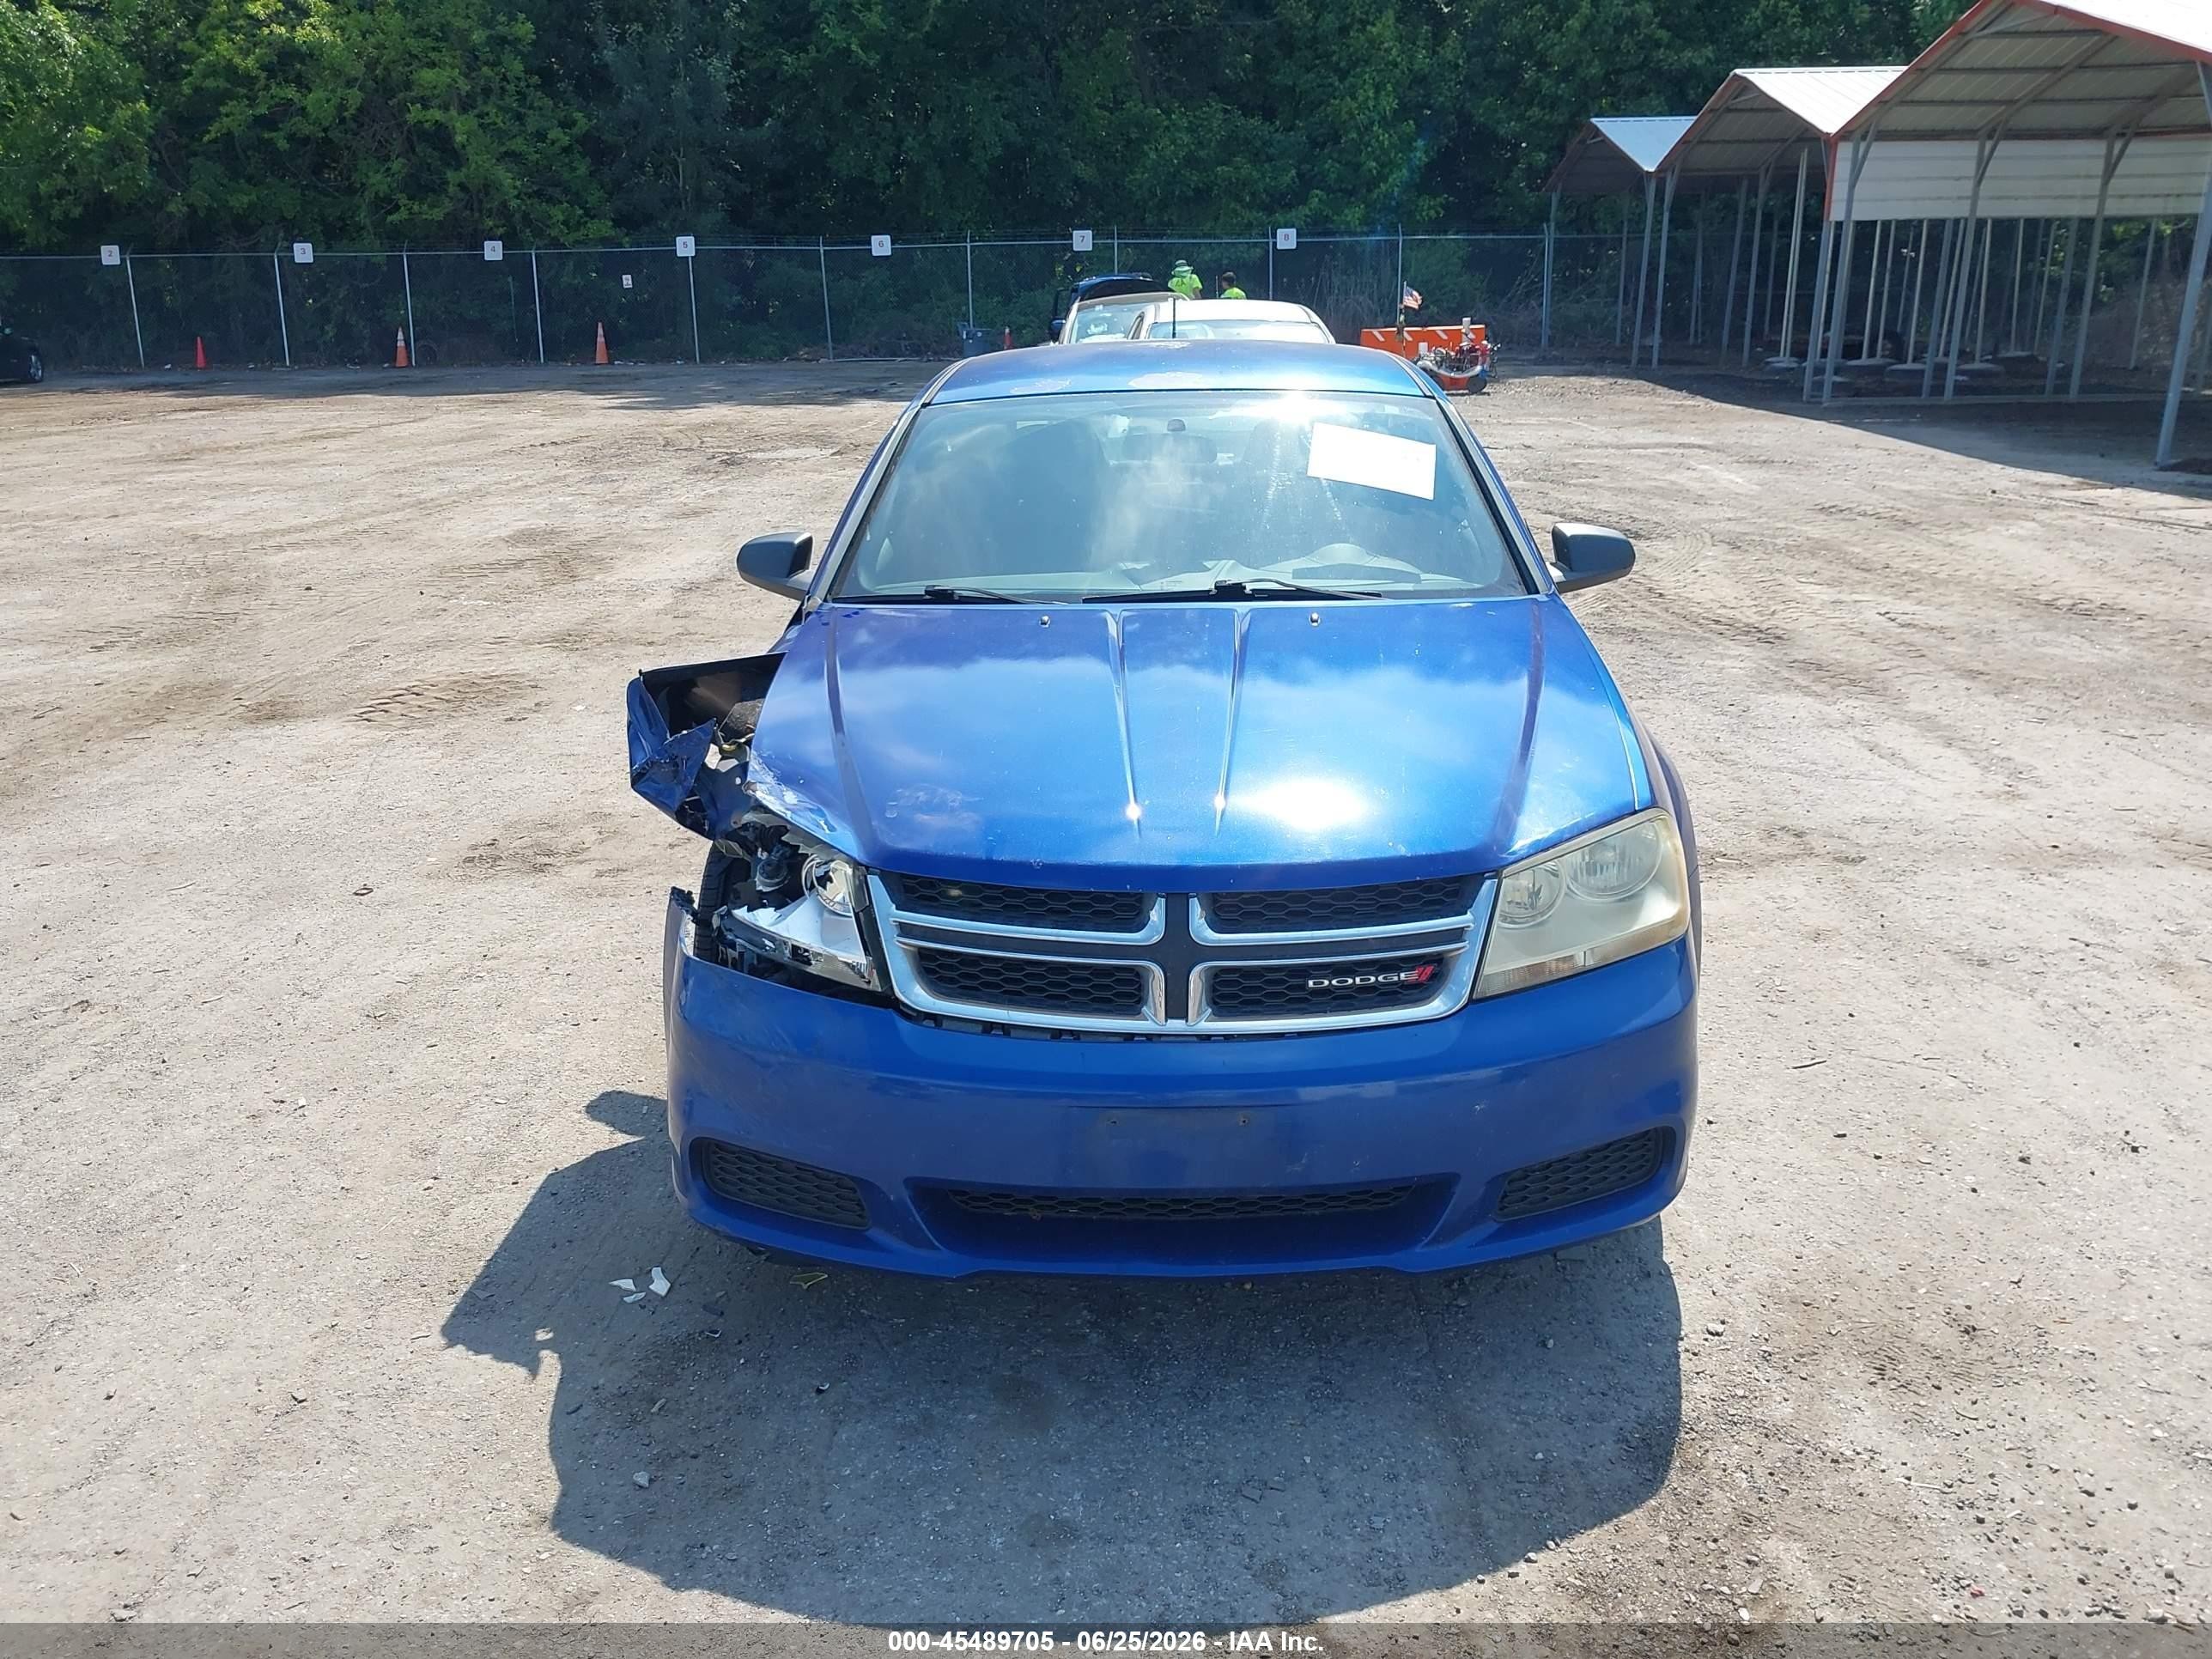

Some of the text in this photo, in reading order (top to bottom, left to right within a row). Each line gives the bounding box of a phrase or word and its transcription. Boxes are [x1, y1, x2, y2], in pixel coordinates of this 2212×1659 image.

[1079, 234, 1085, 243] 7
[1284, 233, 1290, 241] 8
[683, 240, 689, 249] 5
[878, 240, 884, 248] 6
[1308, 970, 1419, 988] DODGE
